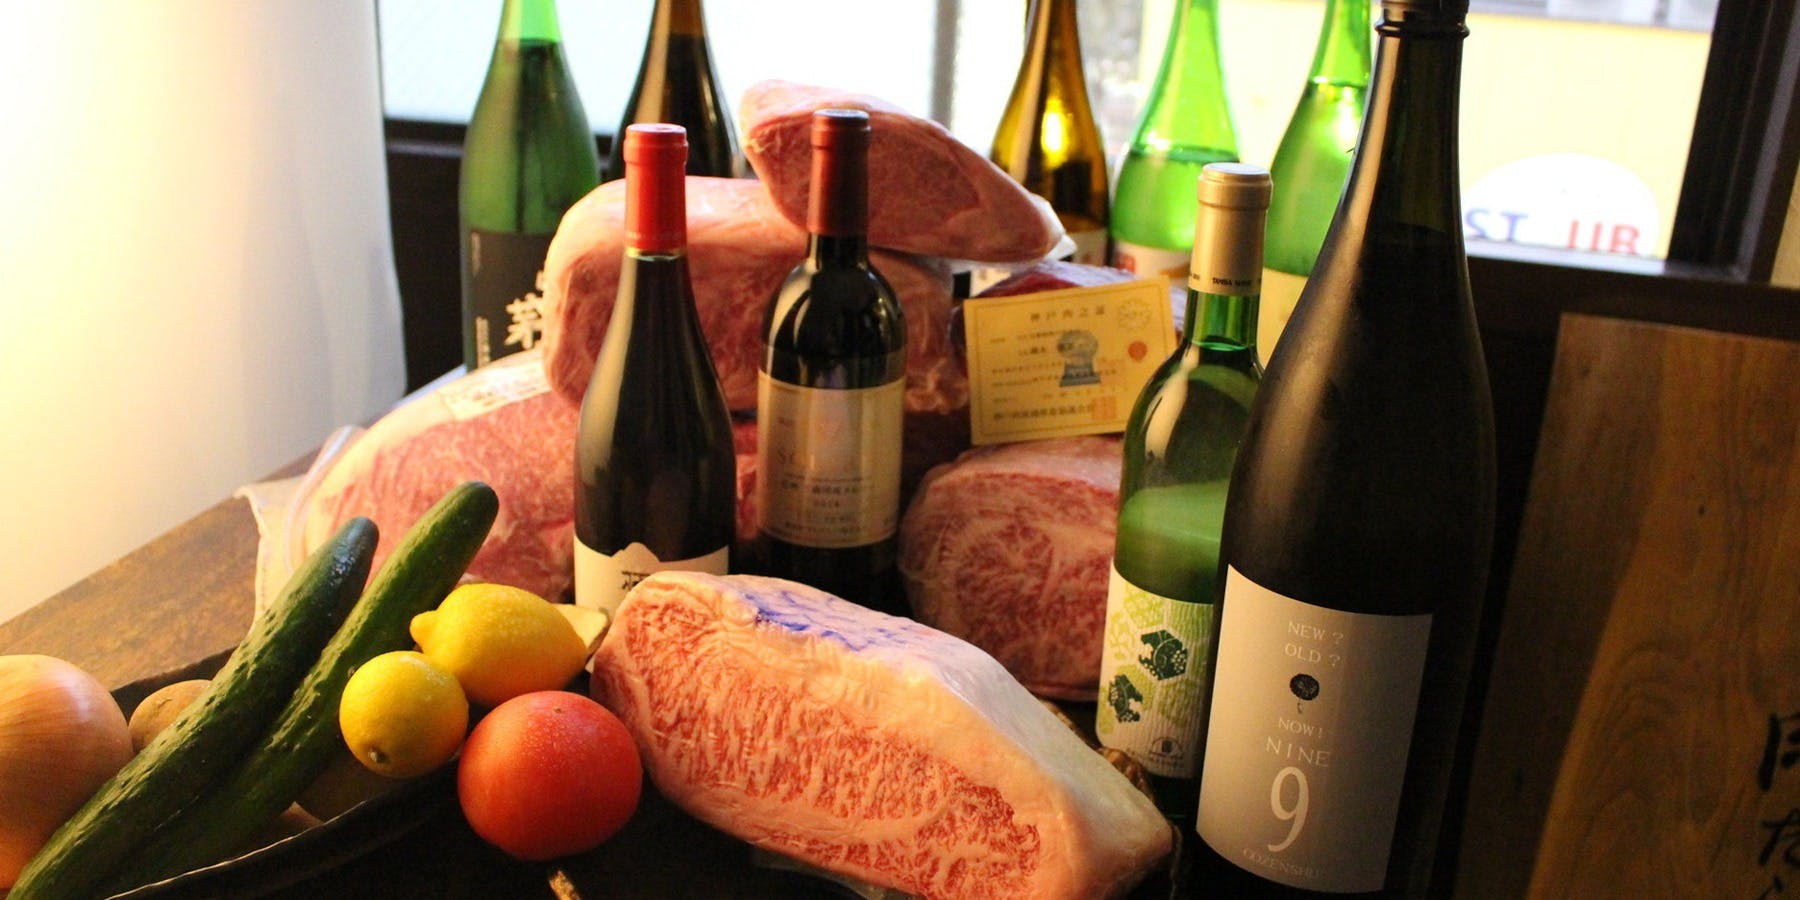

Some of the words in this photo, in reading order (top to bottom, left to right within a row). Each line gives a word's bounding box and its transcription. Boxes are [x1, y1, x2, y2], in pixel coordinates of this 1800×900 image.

[1287, 620, 1326, 641] NEW
[1284, 643, 1321, 664] OLD
[1265, 736, 1331, 768] NINE
[1267, 766, 1310, 852] 9
